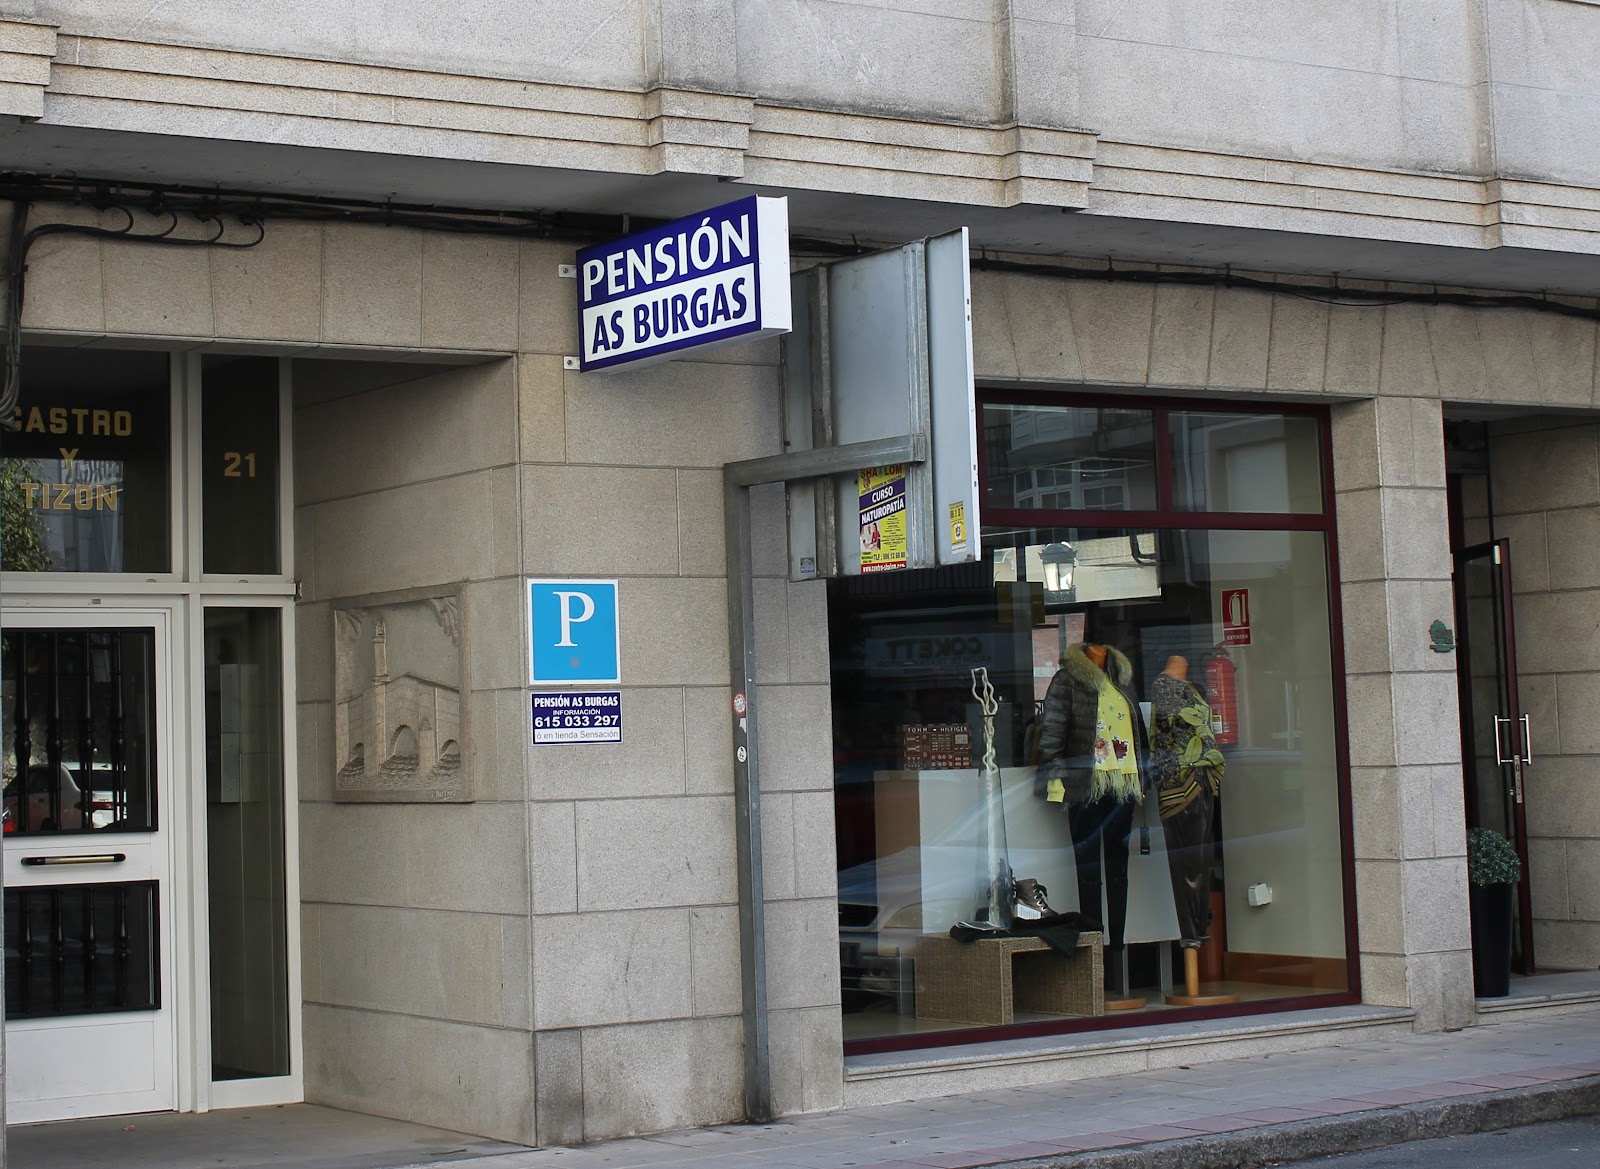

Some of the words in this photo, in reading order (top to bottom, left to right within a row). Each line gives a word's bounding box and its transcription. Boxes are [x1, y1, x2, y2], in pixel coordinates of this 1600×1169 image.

[582, 213, 751, 303] PENSIÓN
[592, 310, 625, 355] AS
[633, 277, 748, 344] BURGAS
[59, 447, 79, 470] Y
[223, 452, 256, 477] 21
[20, 482, 118, 511] TIZON
[871, 485, 893, 503] CURSO
[861, 496, 905, 525] NATUROPATÍA
[553, 591, 595, 647] P
[534, 694, 570, 708] PENSIÓN
[571, 696, 583, 707] AS
[584, 695, 619, 707] BURGAS
[552, 708, 601, 716] INFORMACIÓN
[534, 716, 561, 728] 615
[564, 715, 590, 727] 033
[593, 714, 619, 727] 297
[555, 730, 578, 740] tienda
[580, 730, 619, 739] Sensación
